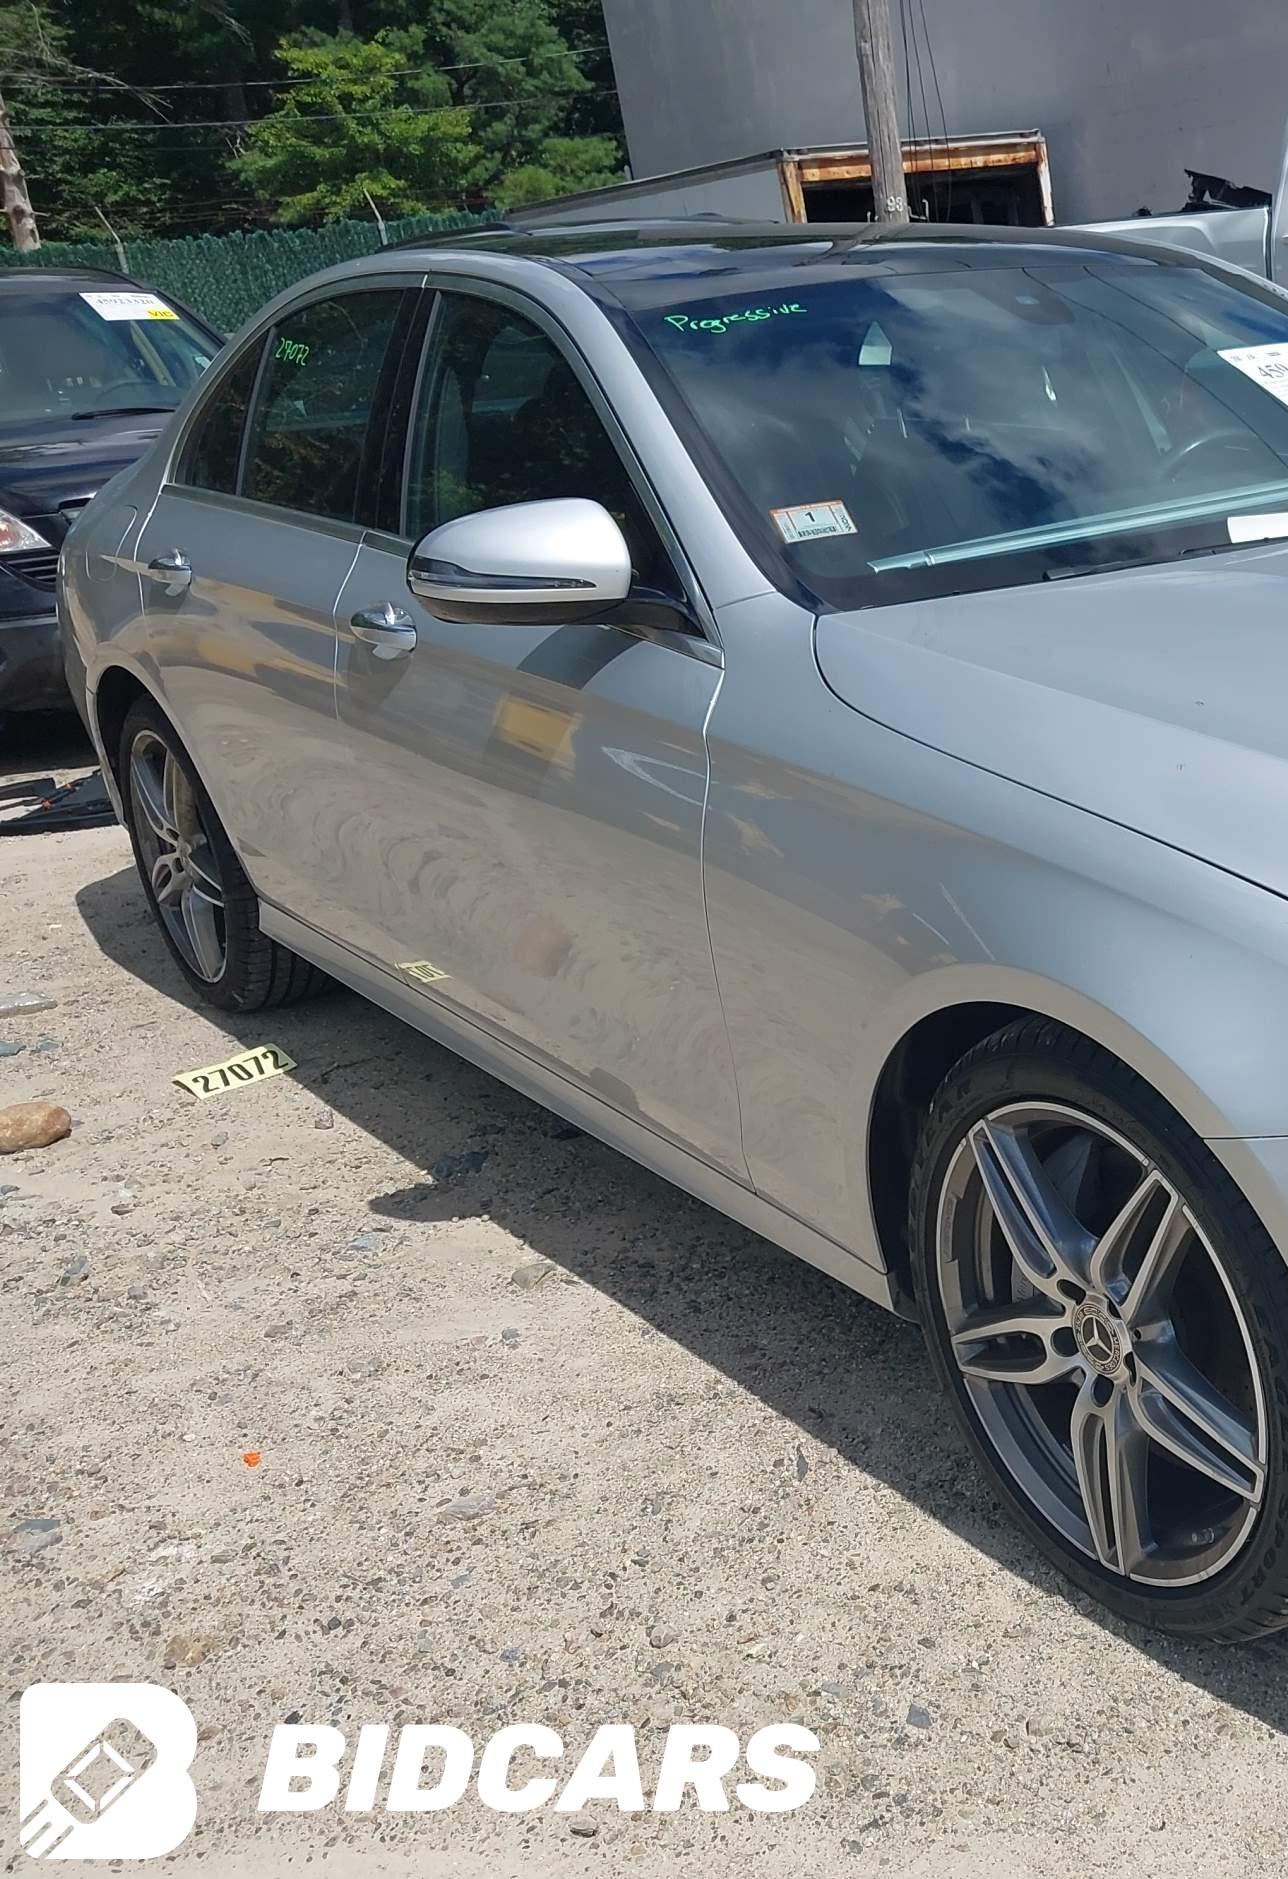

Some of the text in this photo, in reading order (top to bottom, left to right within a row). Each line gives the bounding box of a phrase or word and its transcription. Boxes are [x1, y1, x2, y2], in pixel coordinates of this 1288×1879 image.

[663, 303, 808, 334] Progressive
[275, 337, 310, 366] 27072
[804, 511, 816, 523] 1
[191, 1050, 289, 1093] 27072
